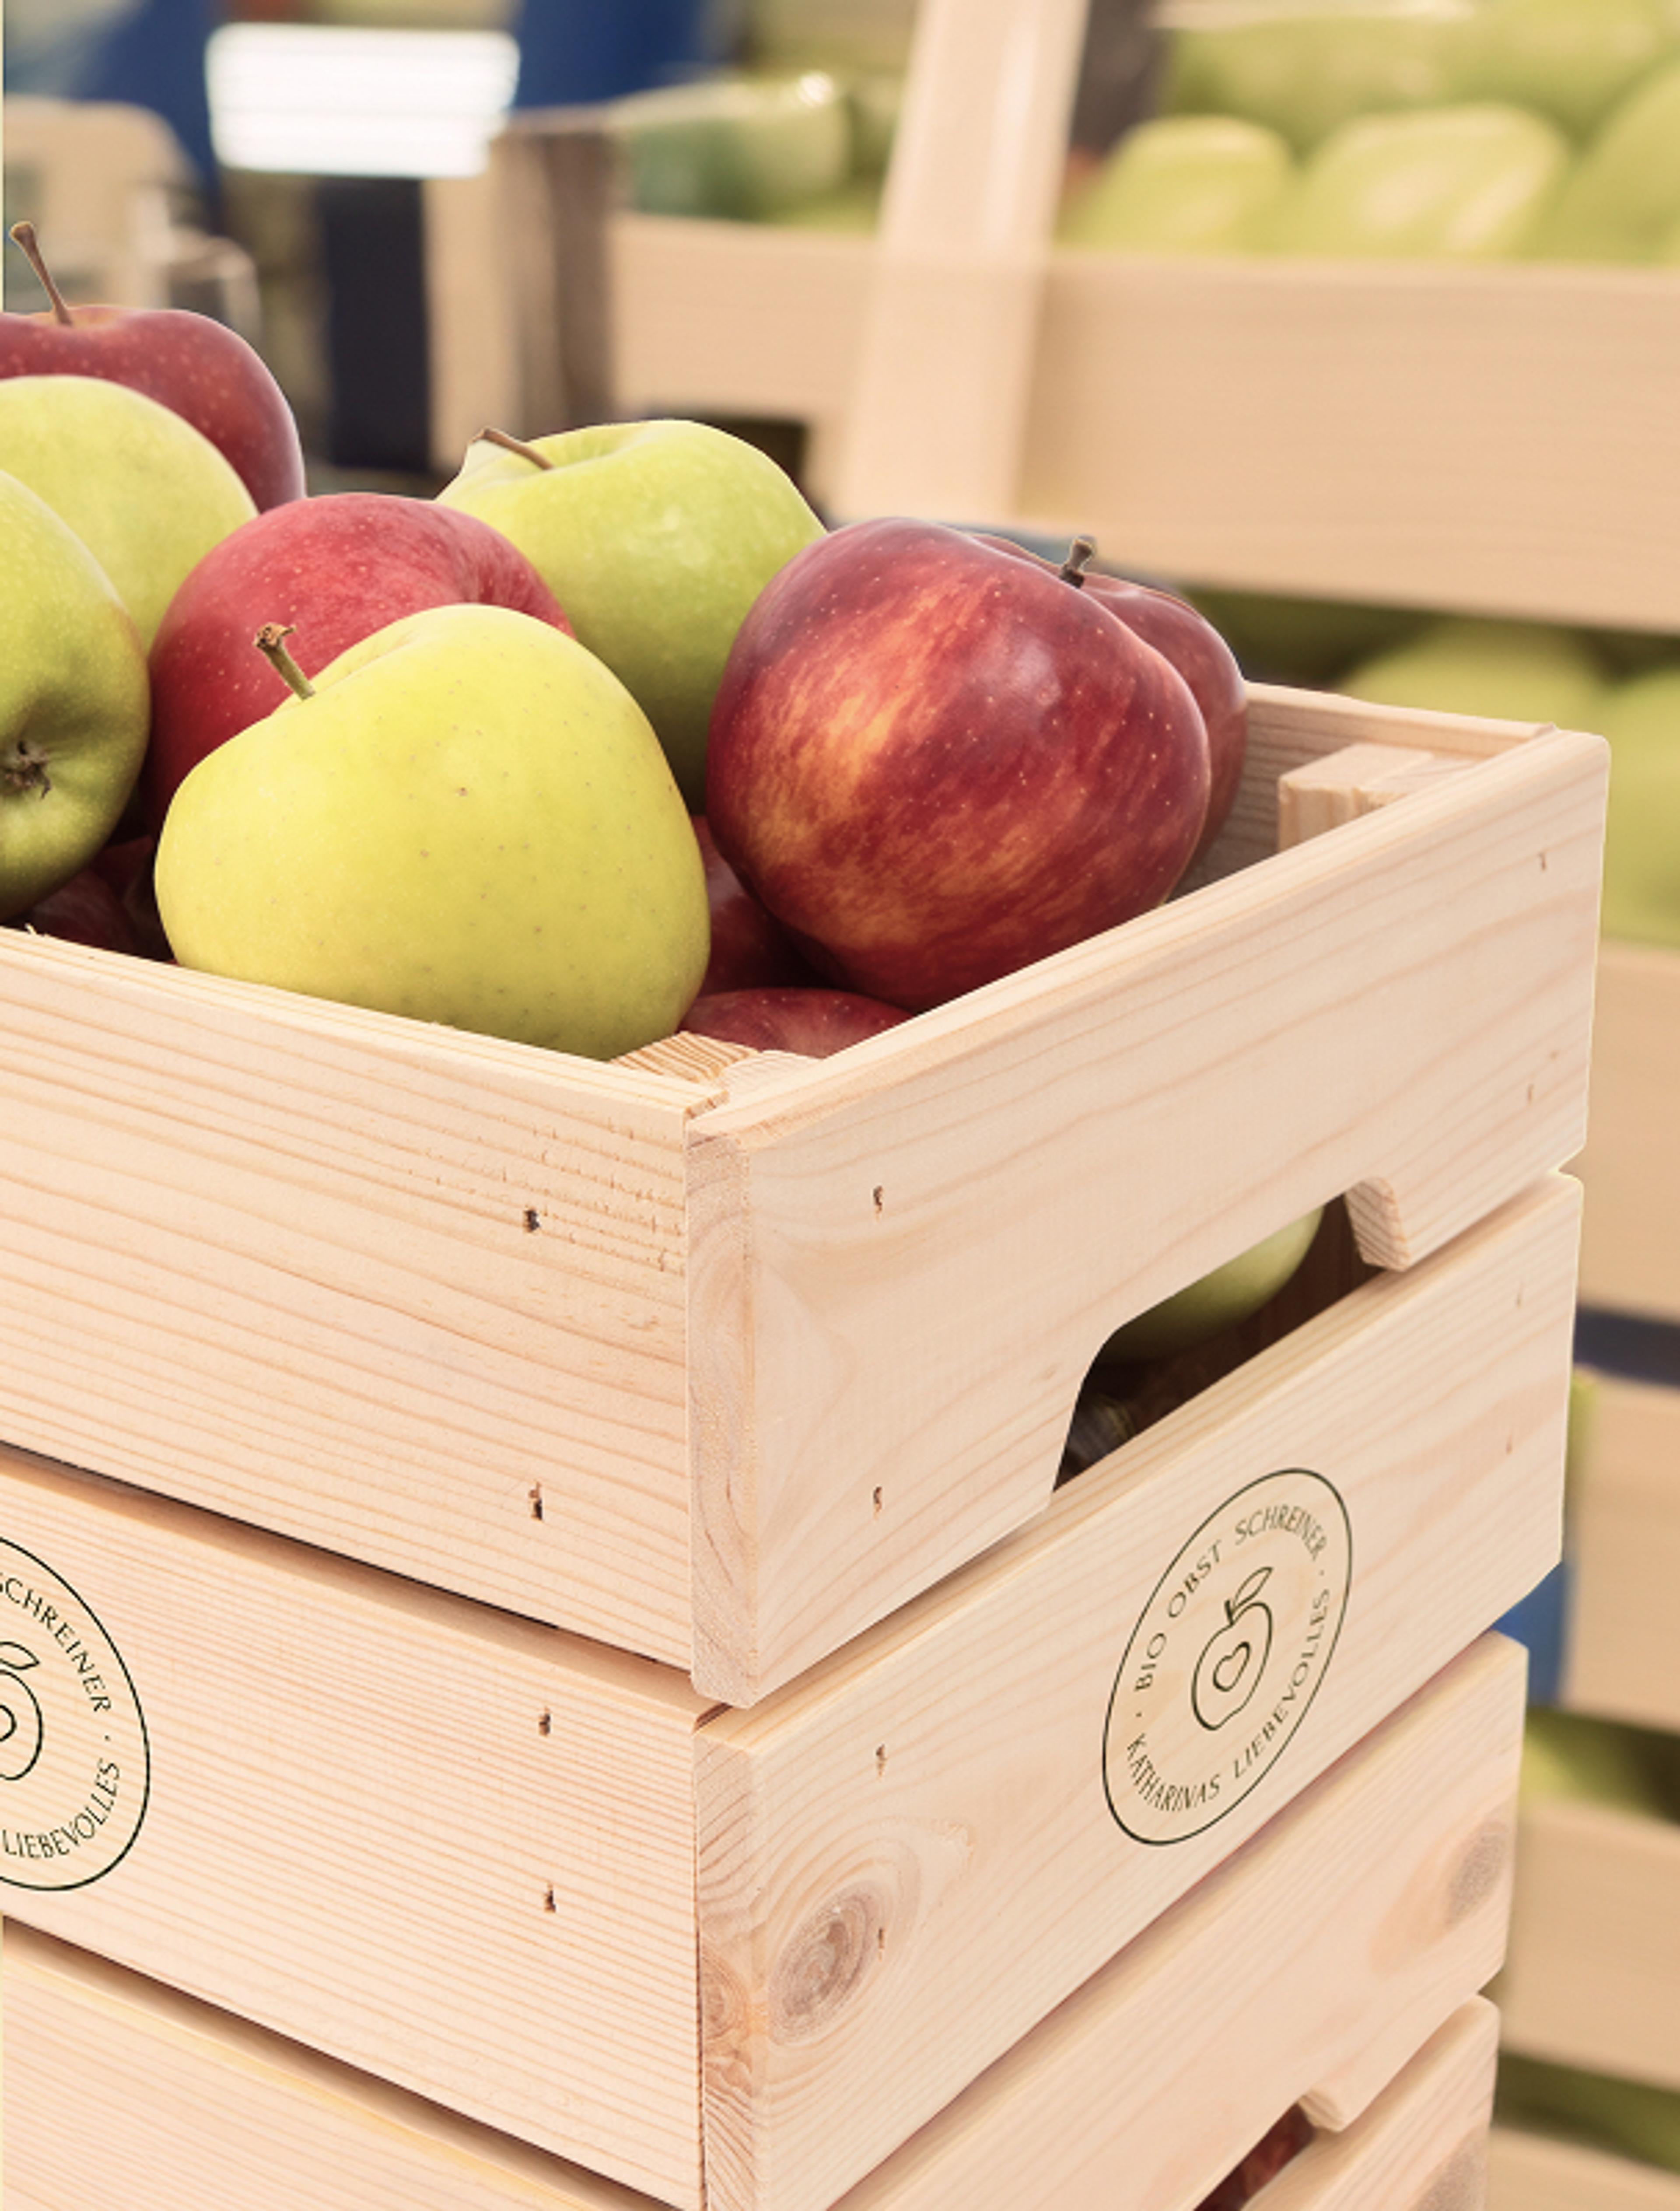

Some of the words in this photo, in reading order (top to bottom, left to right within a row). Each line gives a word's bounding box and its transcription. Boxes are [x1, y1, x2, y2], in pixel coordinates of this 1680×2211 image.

[0, 1573, 111, 1712] CHREINER
[1134, 1632, 1167, 1692] BIO
[1168, 1539, 1222, 1618] OBST
[1235, 1503, 1326, 1561] SCHREINER
[1127, 1733, 1221, 1812] KATHARINAS
[1233, 1588, 1330, 1779] LIEBEVOLLES
[2, 1757, 120, 1858] LIEBEVOLLES
